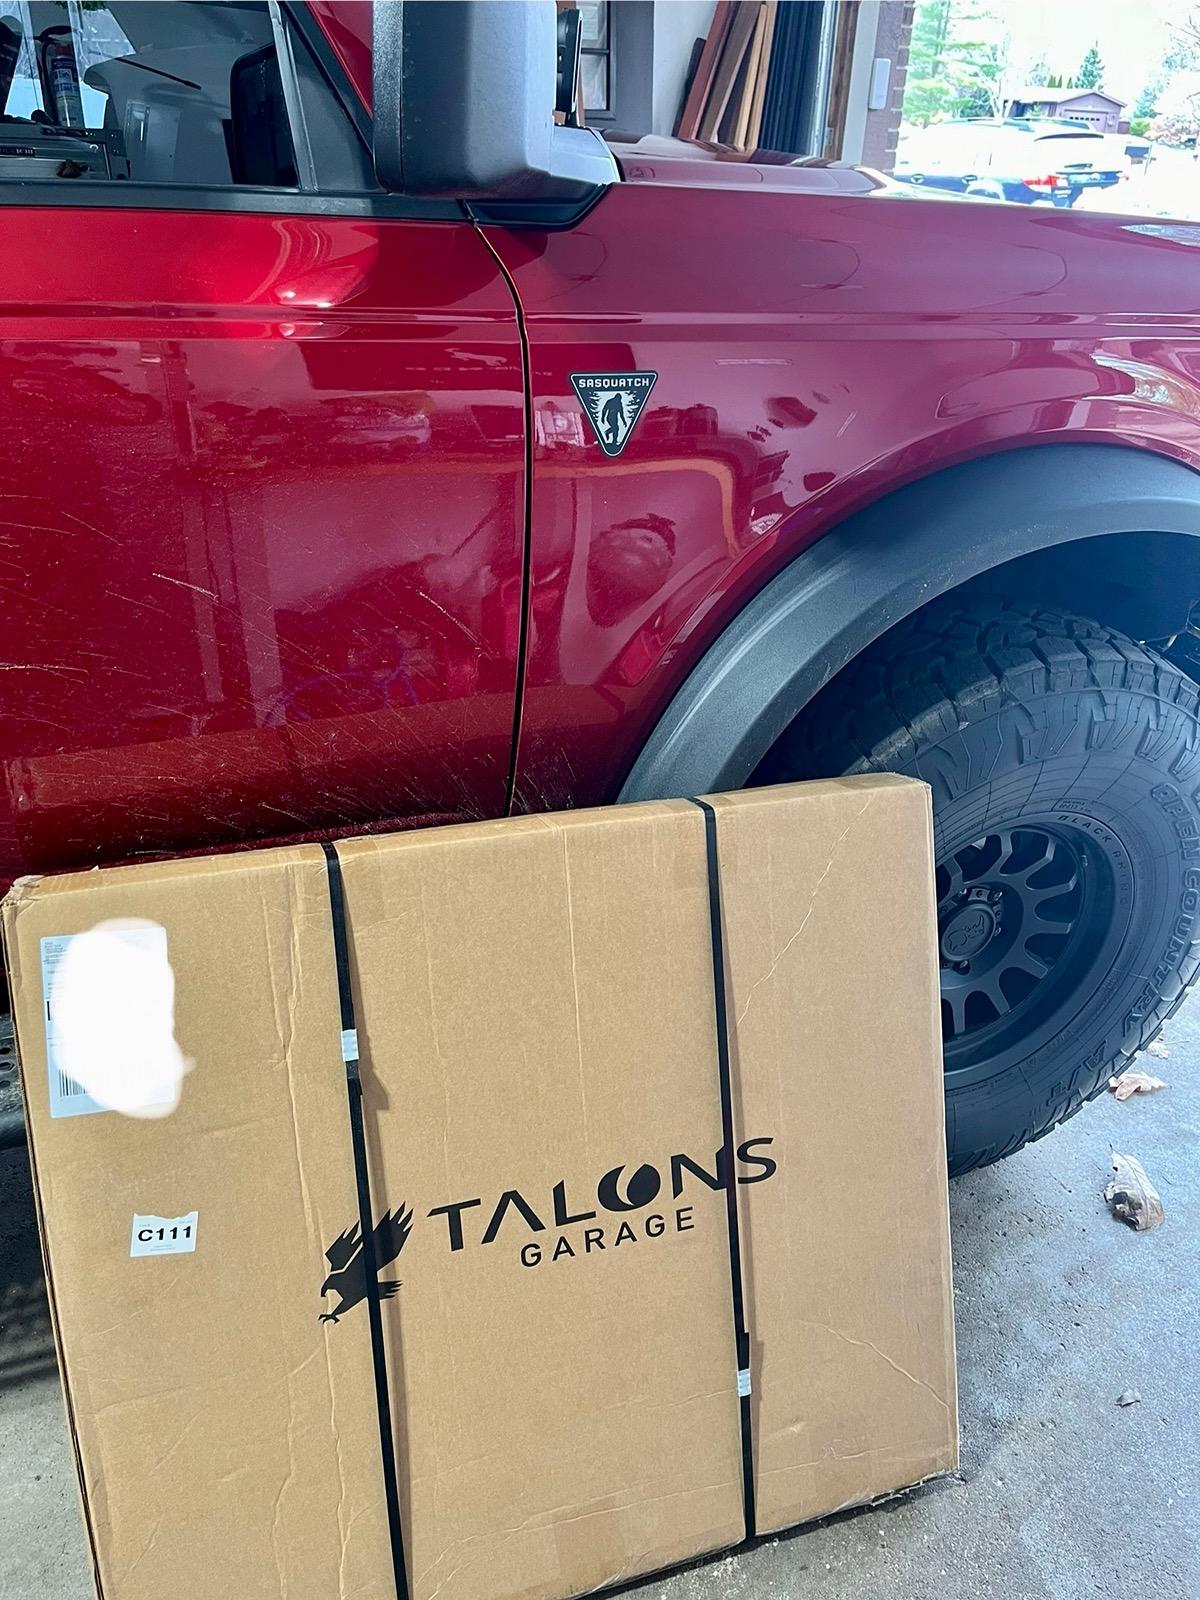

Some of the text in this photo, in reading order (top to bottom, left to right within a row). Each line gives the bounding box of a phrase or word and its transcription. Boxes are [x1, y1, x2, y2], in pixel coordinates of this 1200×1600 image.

[578, 378, 650, 389] SASQUATCH
[1057, 815, 1113, 843] BLACK
[1151, 783, 1200, 860] OPEN
[426, 1137, 777, 1252] TALONS
[137, 1225, 192, 1242] C111
[520, 1206, 695, 1267] GARAGE
